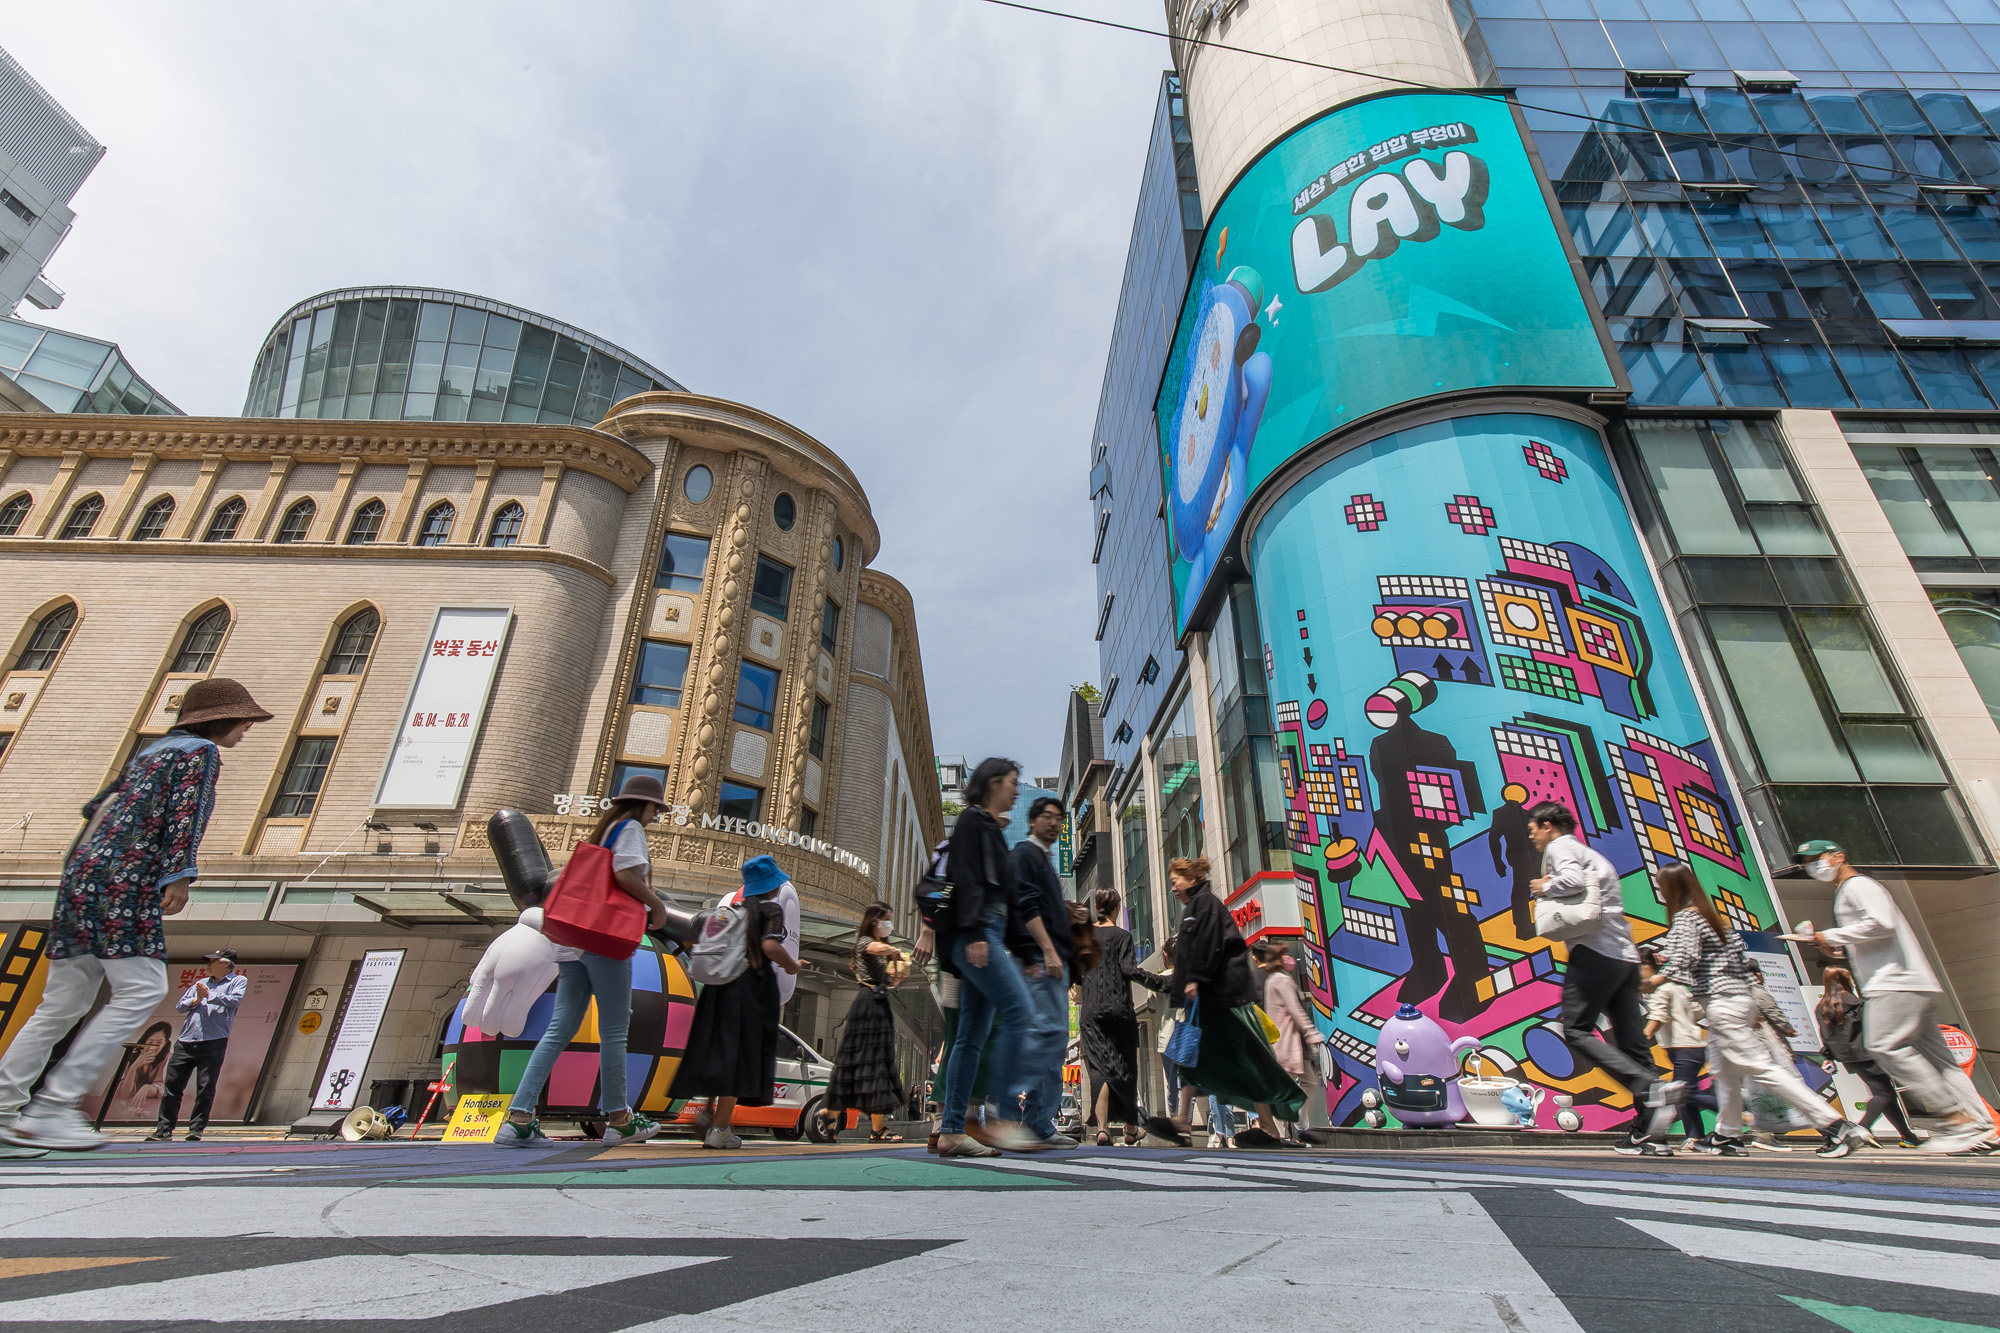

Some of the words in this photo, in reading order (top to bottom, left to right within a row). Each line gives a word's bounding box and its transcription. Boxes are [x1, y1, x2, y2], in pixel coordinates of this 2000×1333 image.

[1293, 176, 1326, 213] 세상
[1329, 152, 1366, 185] 쿨한
[1369, 135, 1408, 162] 힙합
[1411, 122, 1467, 145] 부엉이
[1291, 151, 1472, 293] LAY
[432, 639, 464, 657] 벚꽃
[466, 640, 498, 657] 동산
[701, 812, 832, 858] MYEONGDONG
[310, 997, 321, 1005] 35
[462, 1098, 504, 1109] Homosex
[463, 1112, 472, 1123] is
[473, 1112, 489, 1123] sin.
[451, 1126, 491, 1138] Repent!
